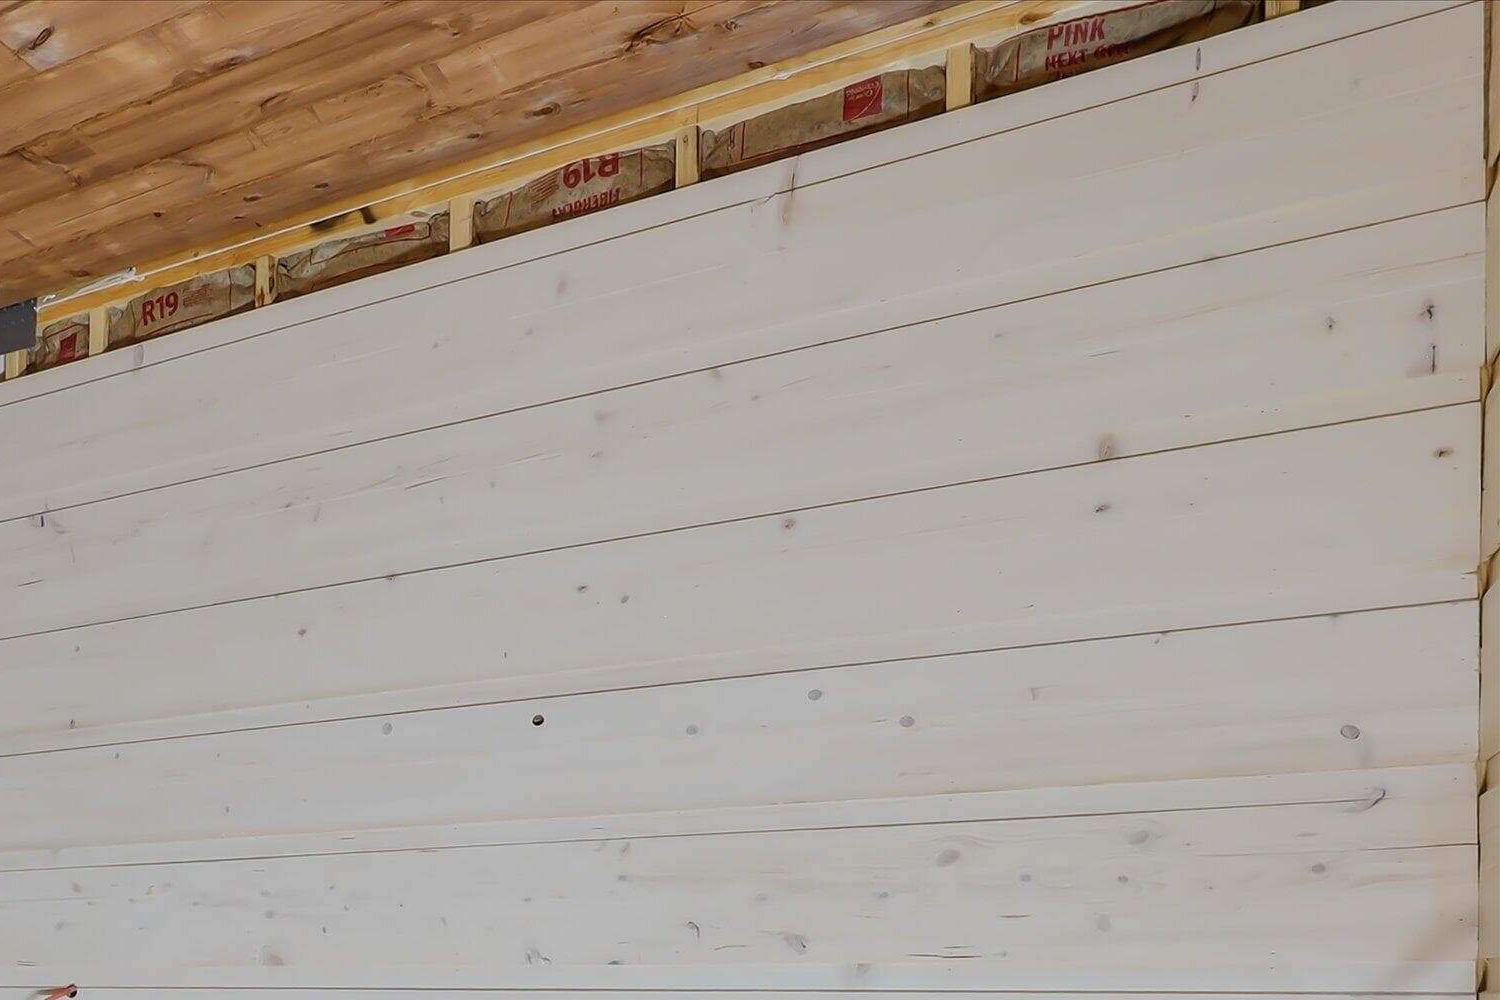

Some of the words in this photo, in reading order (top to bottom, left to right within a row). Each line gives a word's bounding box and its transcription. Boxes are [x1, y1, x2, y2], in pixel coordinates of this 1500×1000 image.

[1046, 18, 1106, 50] PINK
[562, 152, 620, 189] R19
[141, 291, 179, 327] R19
